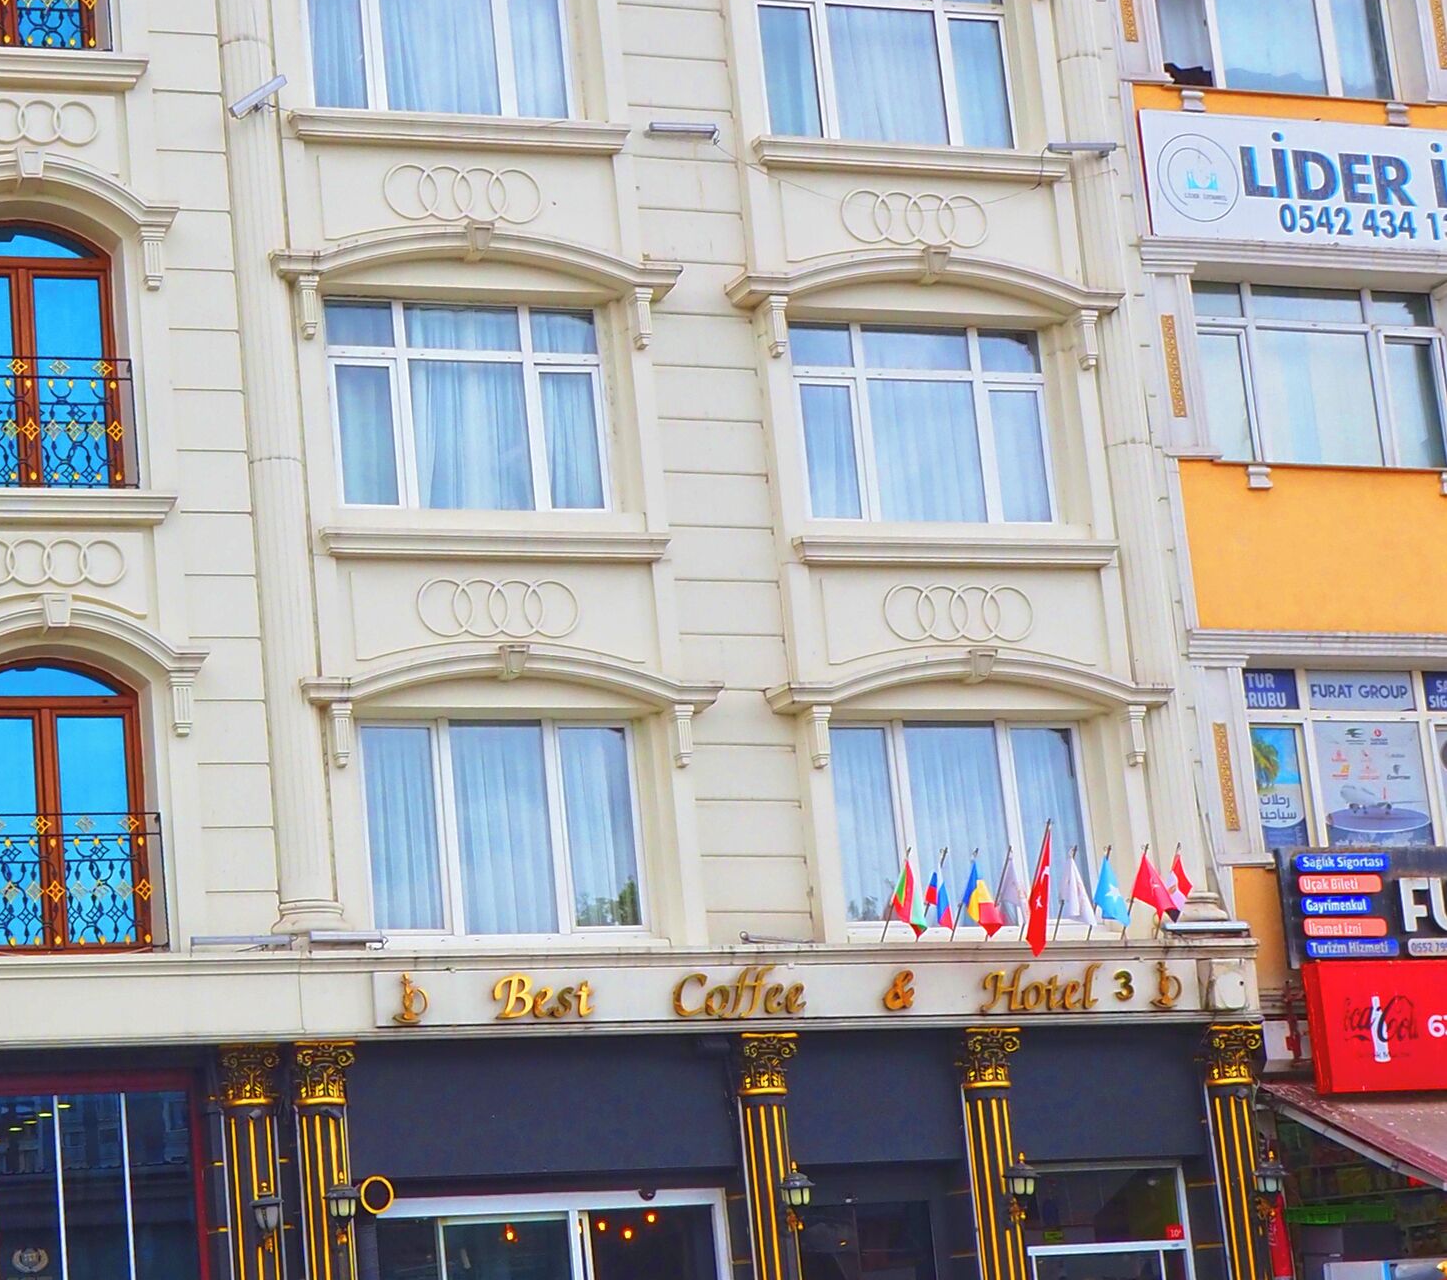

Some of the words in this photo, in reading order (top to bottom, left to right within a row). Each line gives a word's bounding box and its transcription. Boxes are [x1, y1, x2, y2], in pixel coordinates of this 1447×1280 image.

[1239, 131, 1417, 207] LİDER
[1279, 204, 1354, 236] 0542
[1362, 209, 1418, 240] 434
[1245, 673, 1275, 689] TUR
[1310, 683, 1354, 699] FURAT
[1358, 684, 1408, 699] GROUP
[1244, 691, 1287, 708] RUBU
[1259, 809, 1297, 823] سياحي
[1303, 877, 1330, 892] Uçak
[1331, 877, 1359, 891] Bileti
[1305, 898, 1367, 913] Gayrimenkul
[1310, 941, 1347, 954] Turizm
[1349, 940, 1389, 953] Hizmeti
[493, 971, 597, 1019] Best
[672, 964, 808, 1019] Coffee
[883, 969, 916, 1011] &
[980, 963, 1102, 1013] Hotel
[1112, 968, 1136, 1002] 3
[1427, 1014, 1447, 1038] 6
